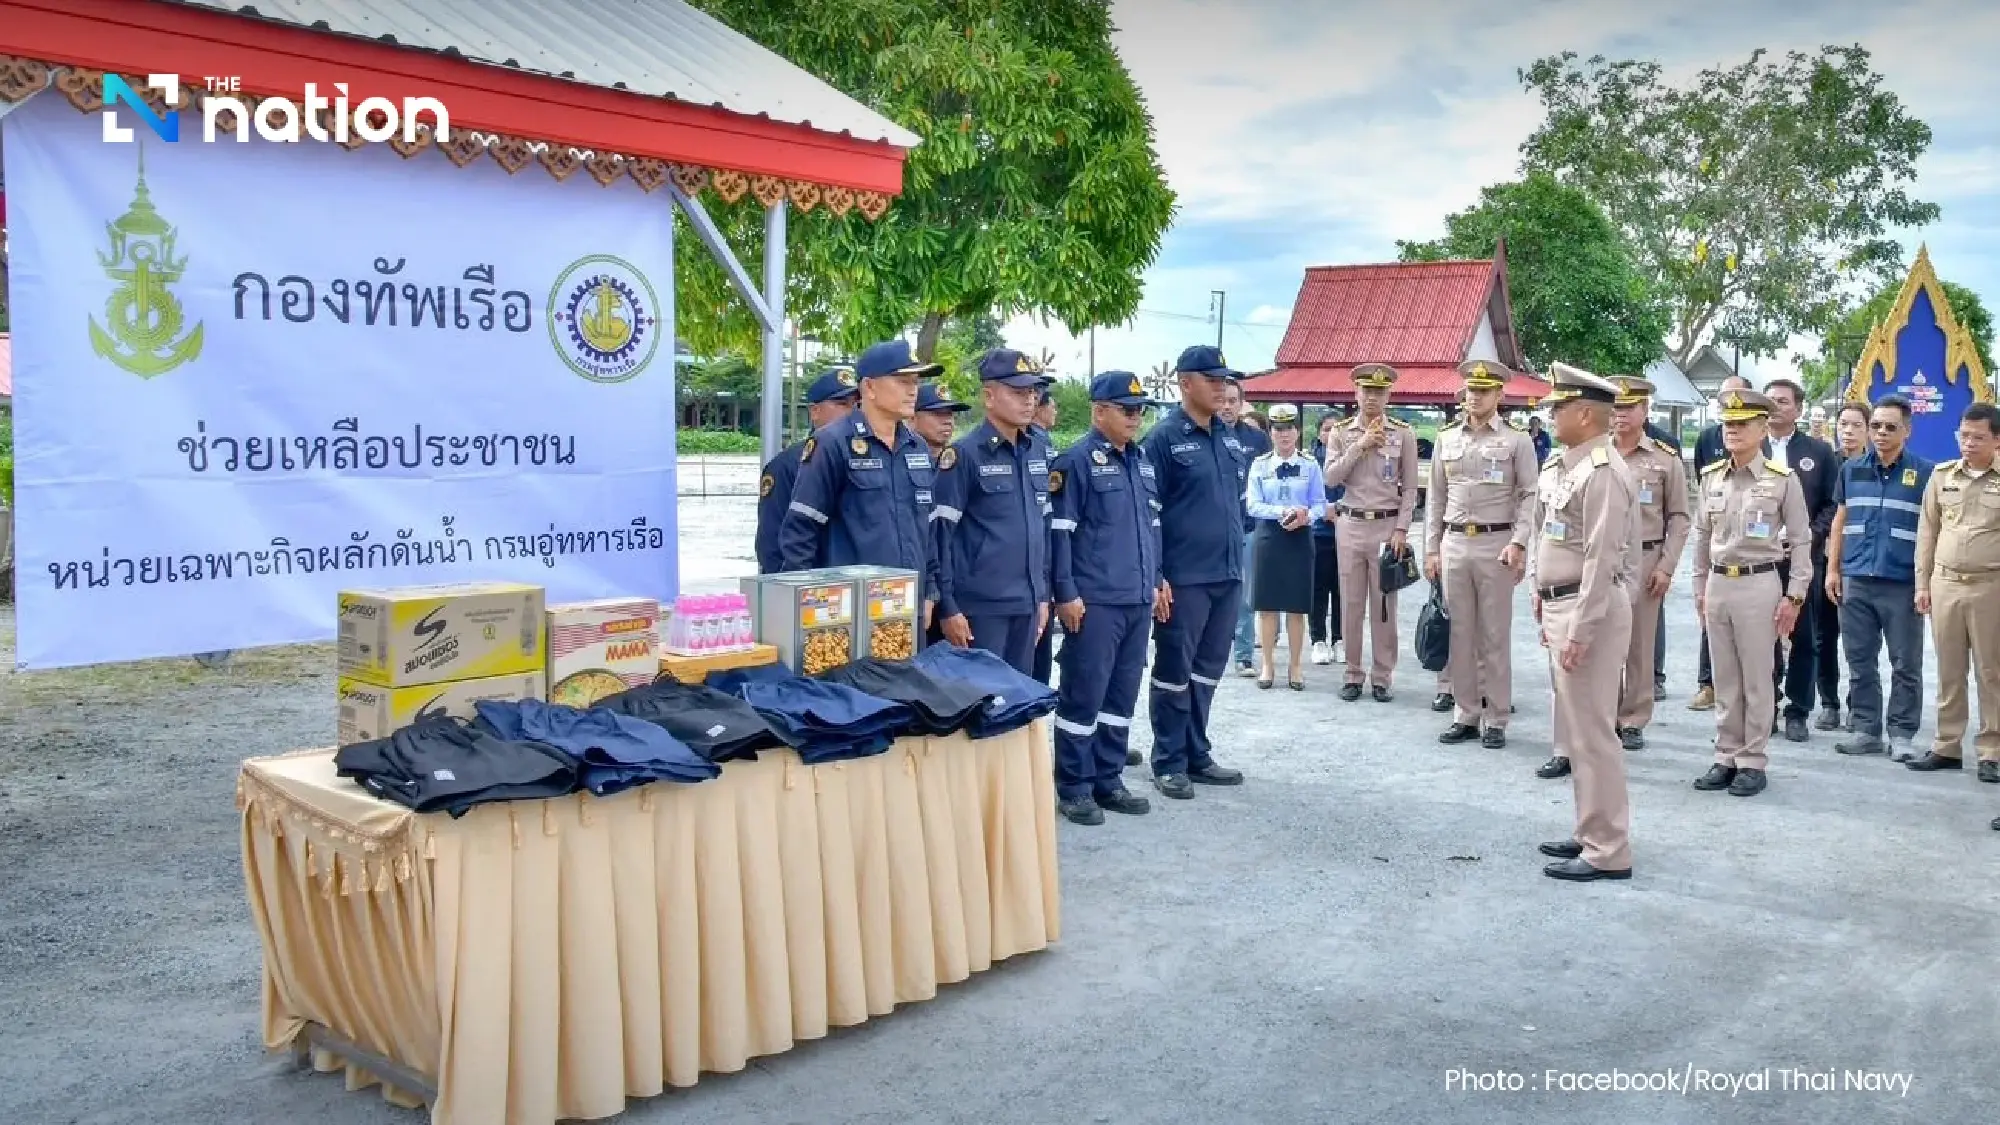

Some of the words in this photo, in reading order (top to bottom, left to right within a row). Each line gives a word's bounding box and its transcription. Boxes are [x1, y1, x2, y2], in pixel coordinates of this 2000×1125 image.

[231, 256, 532, 333] กองทัพเรือ
[178, 416, 576, 473] ช่วยเหลือประชาชน
[47, 515, 473, 590] หน่วยเฉพาะกิจผลักดันน้ำ
[484, 516, 664, 569] กรมอู่ทหารเรือ
[605, 641, 650, 661] MAMA
